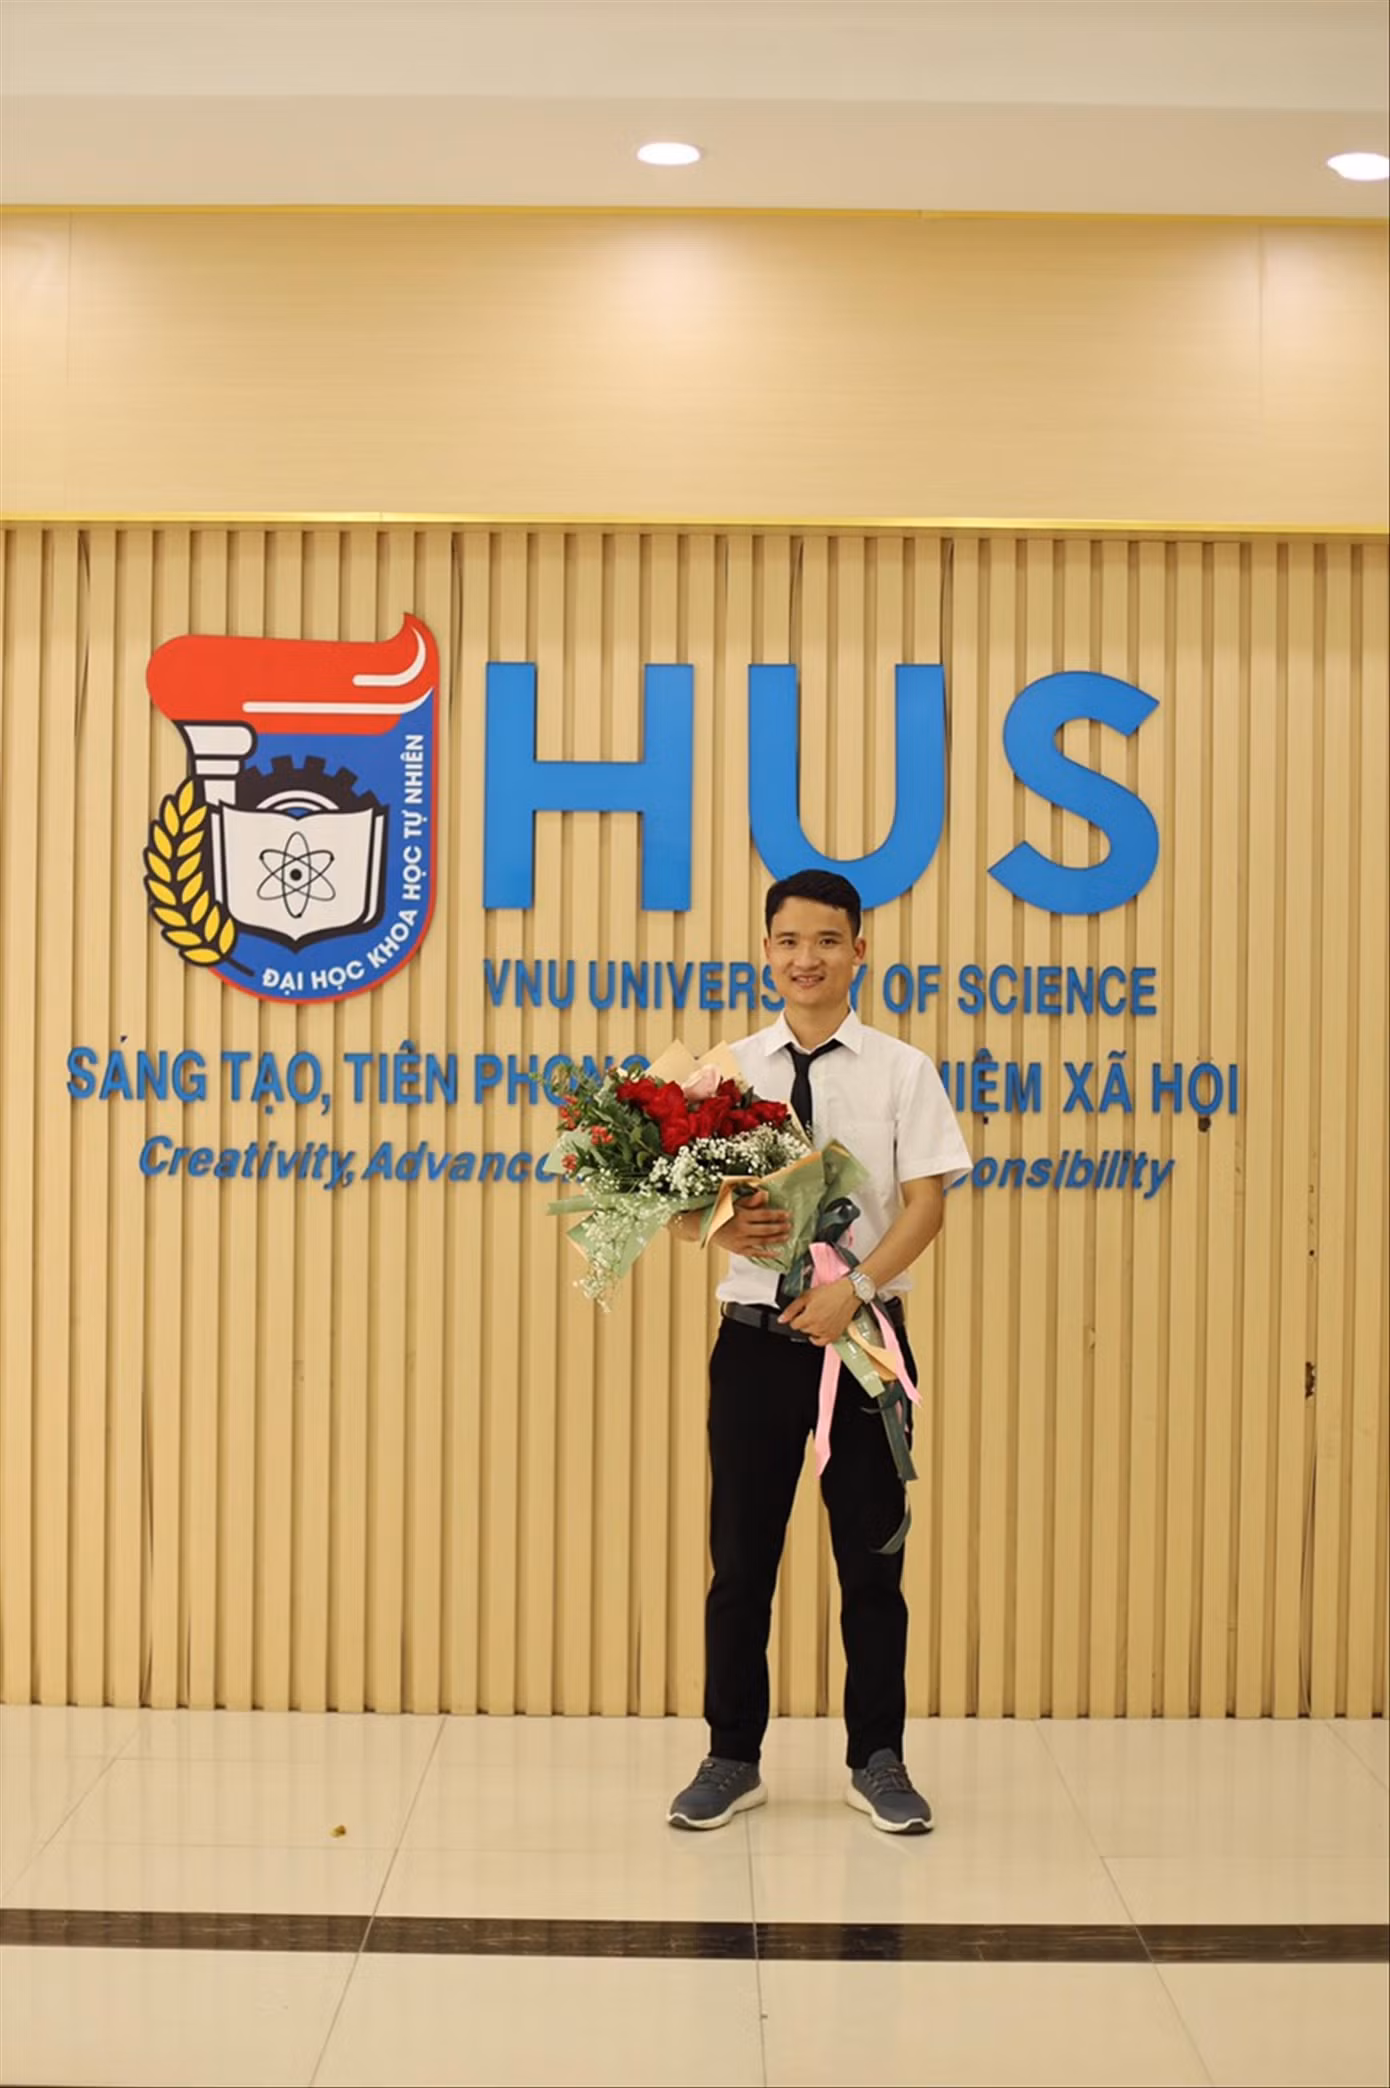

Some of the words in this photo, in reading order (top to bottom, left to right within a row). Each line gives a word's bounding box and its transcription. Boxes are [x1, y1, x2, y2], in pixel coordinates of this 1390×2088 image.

[400, 734, 425, 804] NHIÊN
[483, 661, 1160, 916] HUS
[402, 810, 428, 839] TỰ
[402, 846, 427, 900] HỌC
[367, 909, 418, 969] KHOA
[262, 967, 304, 996] ĐẠI
[311, 961, 366, 991] HỌC
[483, 958, 576, 1009] VNU
[588, 960, 868, 1013] UNIVERSY
[883, 963, 941, 1014] OF
[957, 964, 1157, 1016] SCIENCE
[220, 1050, 332, 1115] TẠO,
[343, 1039, 459, 1104] TIÊN
[1063, 1050, 1133, 1114] XÃ
[139, 1135, 357, 1191] Creativity,
